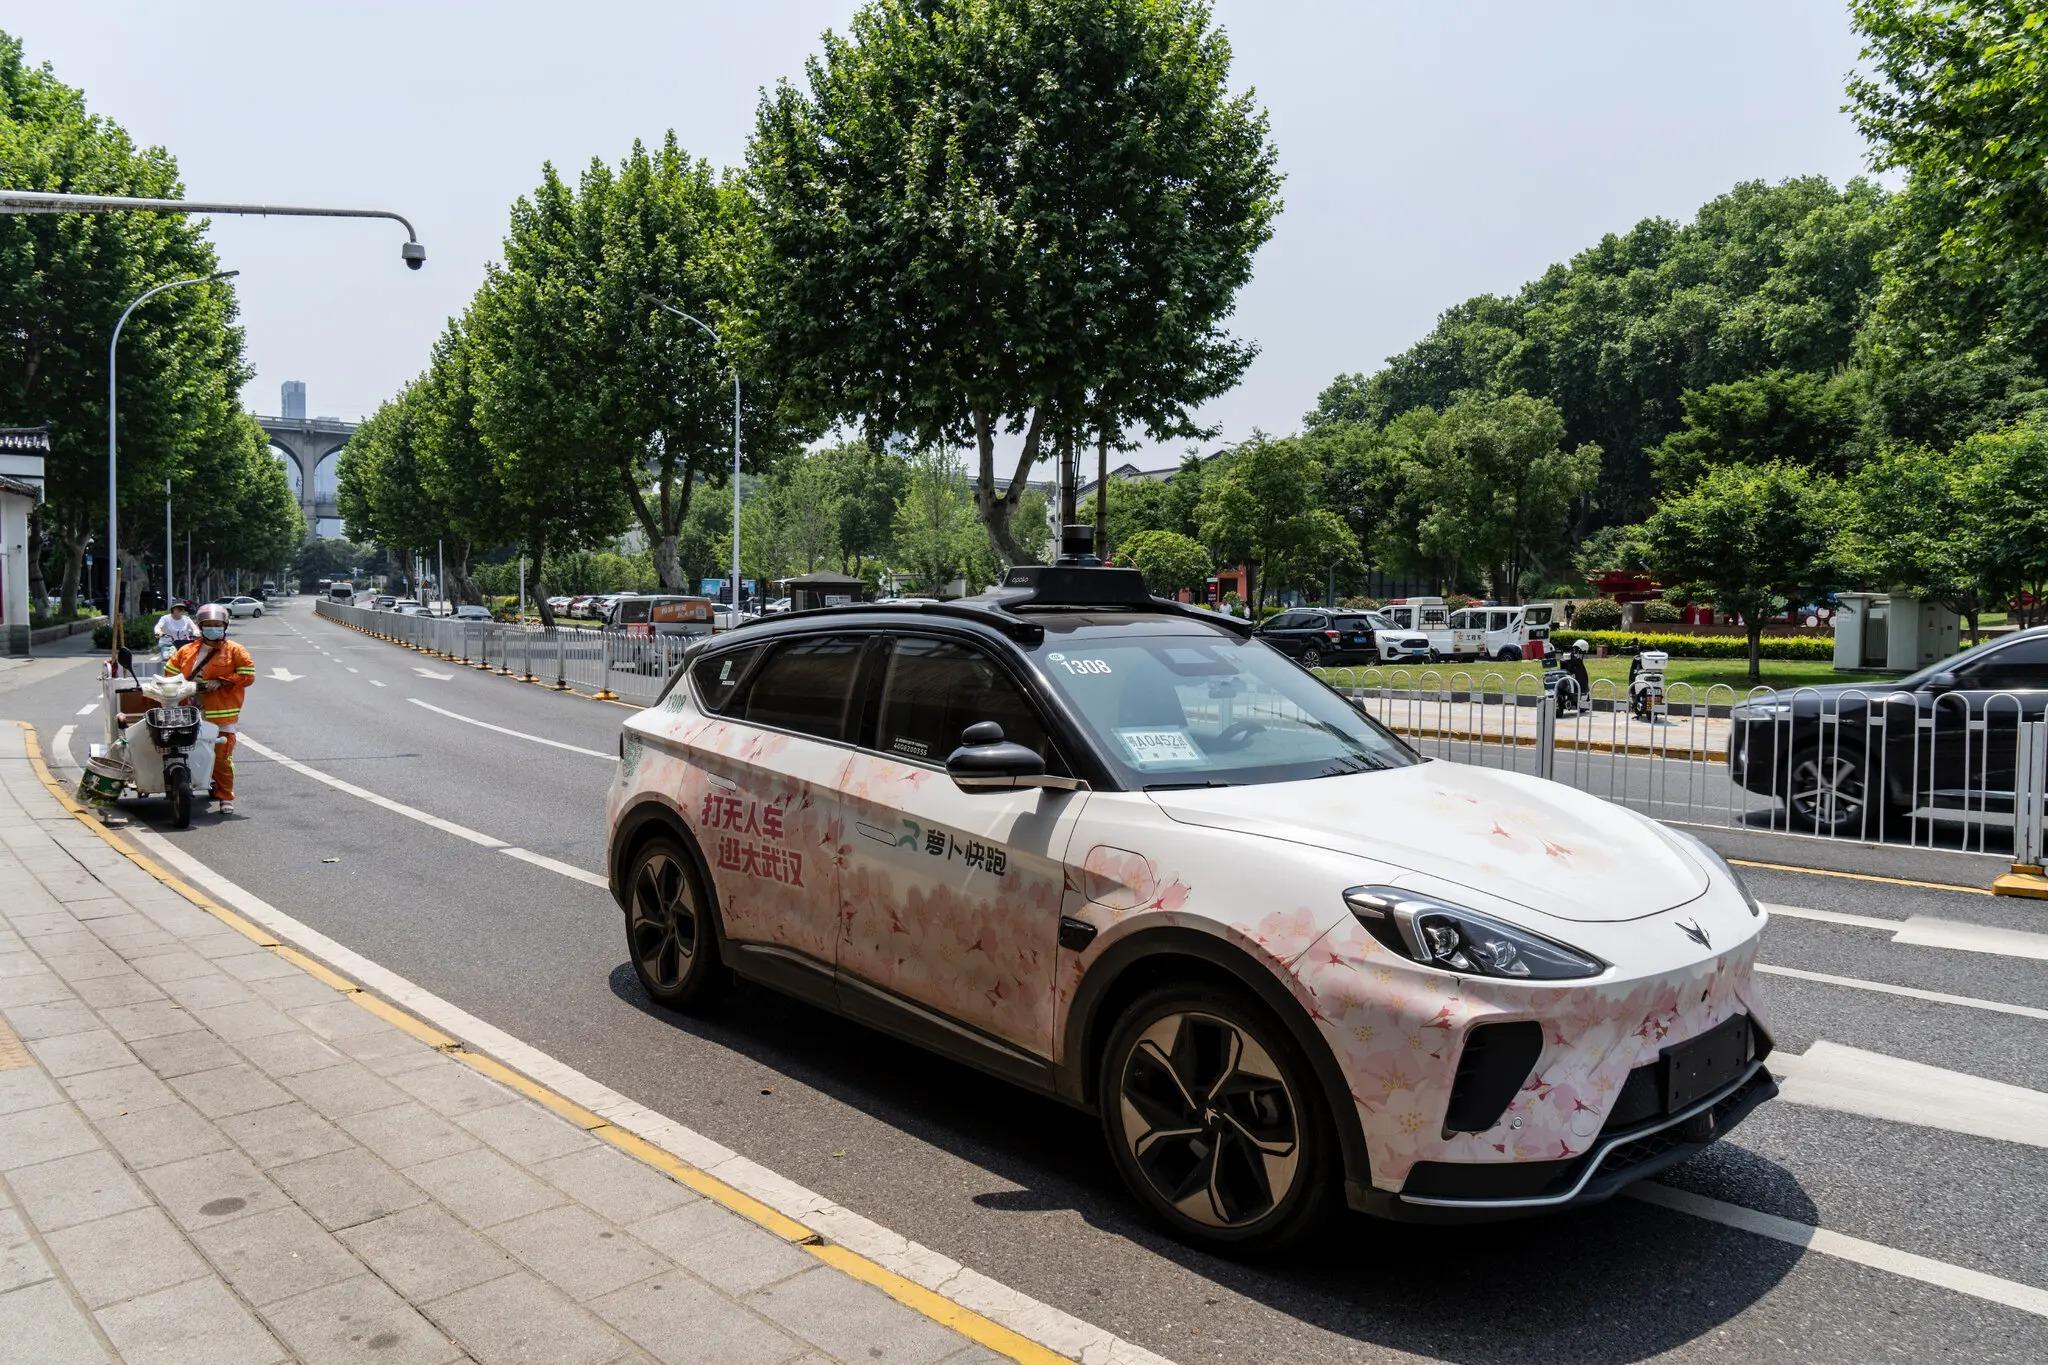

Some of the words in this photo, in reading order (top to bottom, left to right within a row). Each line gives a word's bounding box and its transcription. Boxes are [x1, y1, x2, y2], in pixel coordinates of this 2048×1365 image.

[1061, 660, 1111, 674] 1308
[702, 793, 783, 840] 打无人车
[718, 836, 805, 888] 逛大武汉
[925, 829, 1006, 876] 萝卜快跑
